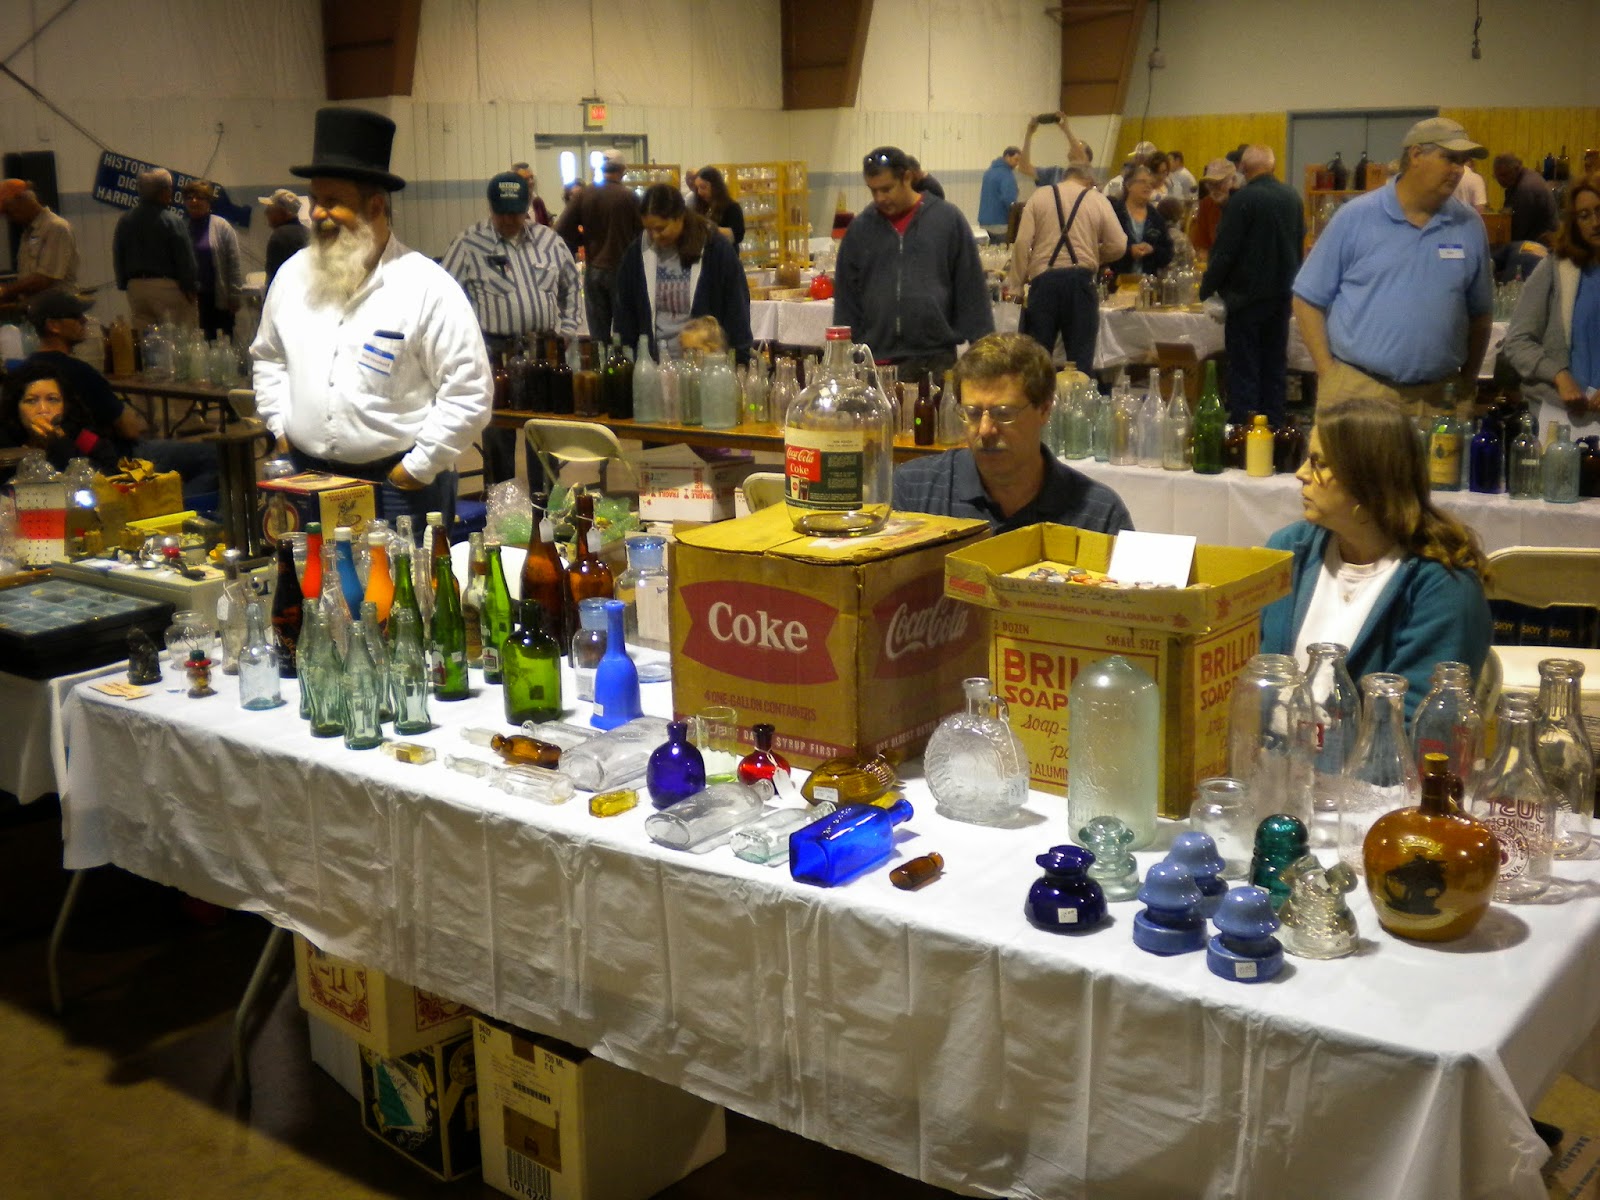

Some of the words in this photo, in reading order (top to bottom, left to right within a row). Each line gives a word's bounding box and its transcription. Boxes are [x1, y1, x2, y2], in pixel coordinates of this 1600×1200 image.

[103, 153, 147, 175] HISTOR
[790, 463, 810, 475] Coke
[708, 601, 809, 653] Coke
[1002, 621, 1030, 635] DOZEN
[1105, 635, 1135, 649] SMALL
[1140, 638, 1161, 651] SIZE
[1004, 685, 1068, 711] SOAP
[764, 700, 817, 722] CONTAINERS
[776, 736, 806, 750] SYRUP
[810, 741, 838, 757] FIRST
